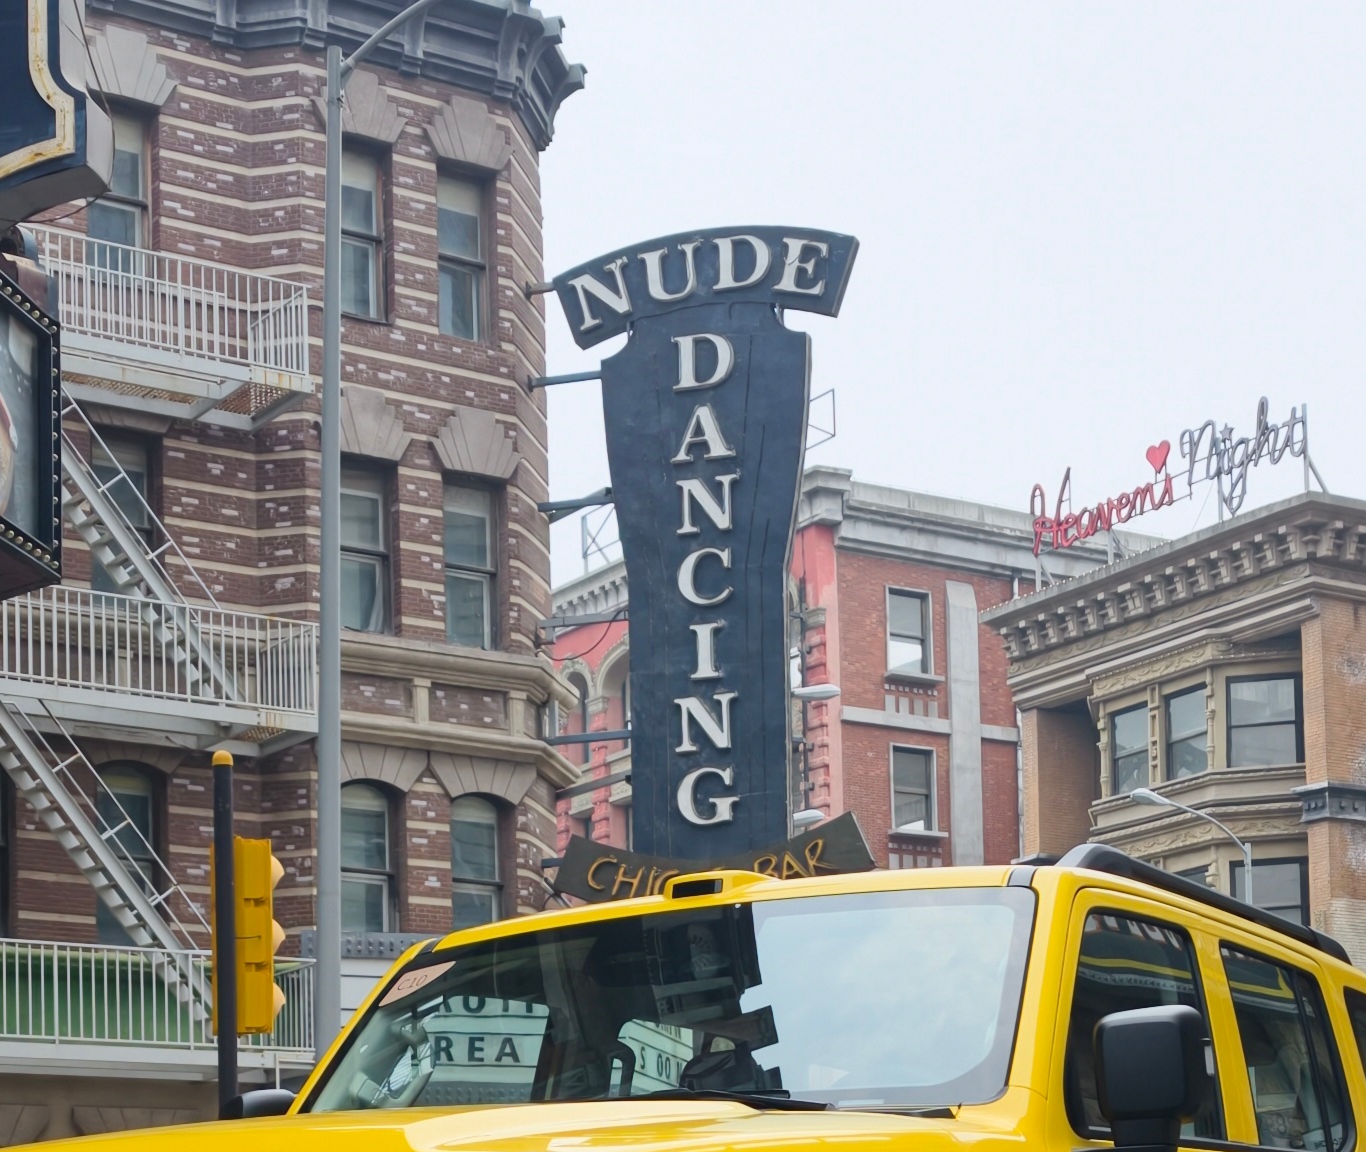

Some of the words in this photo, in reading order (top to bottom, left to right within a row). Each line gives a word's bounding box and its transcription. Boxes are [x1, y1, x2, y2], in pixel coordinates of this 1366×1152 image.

[567, 234, 829, 332] NUDE
[1180, 397, 1307, 514] Night
[671, 333, 741, 827] DANCING
[754, 838, 825, 880] BAR
[397, 975, 429, 991] C10
